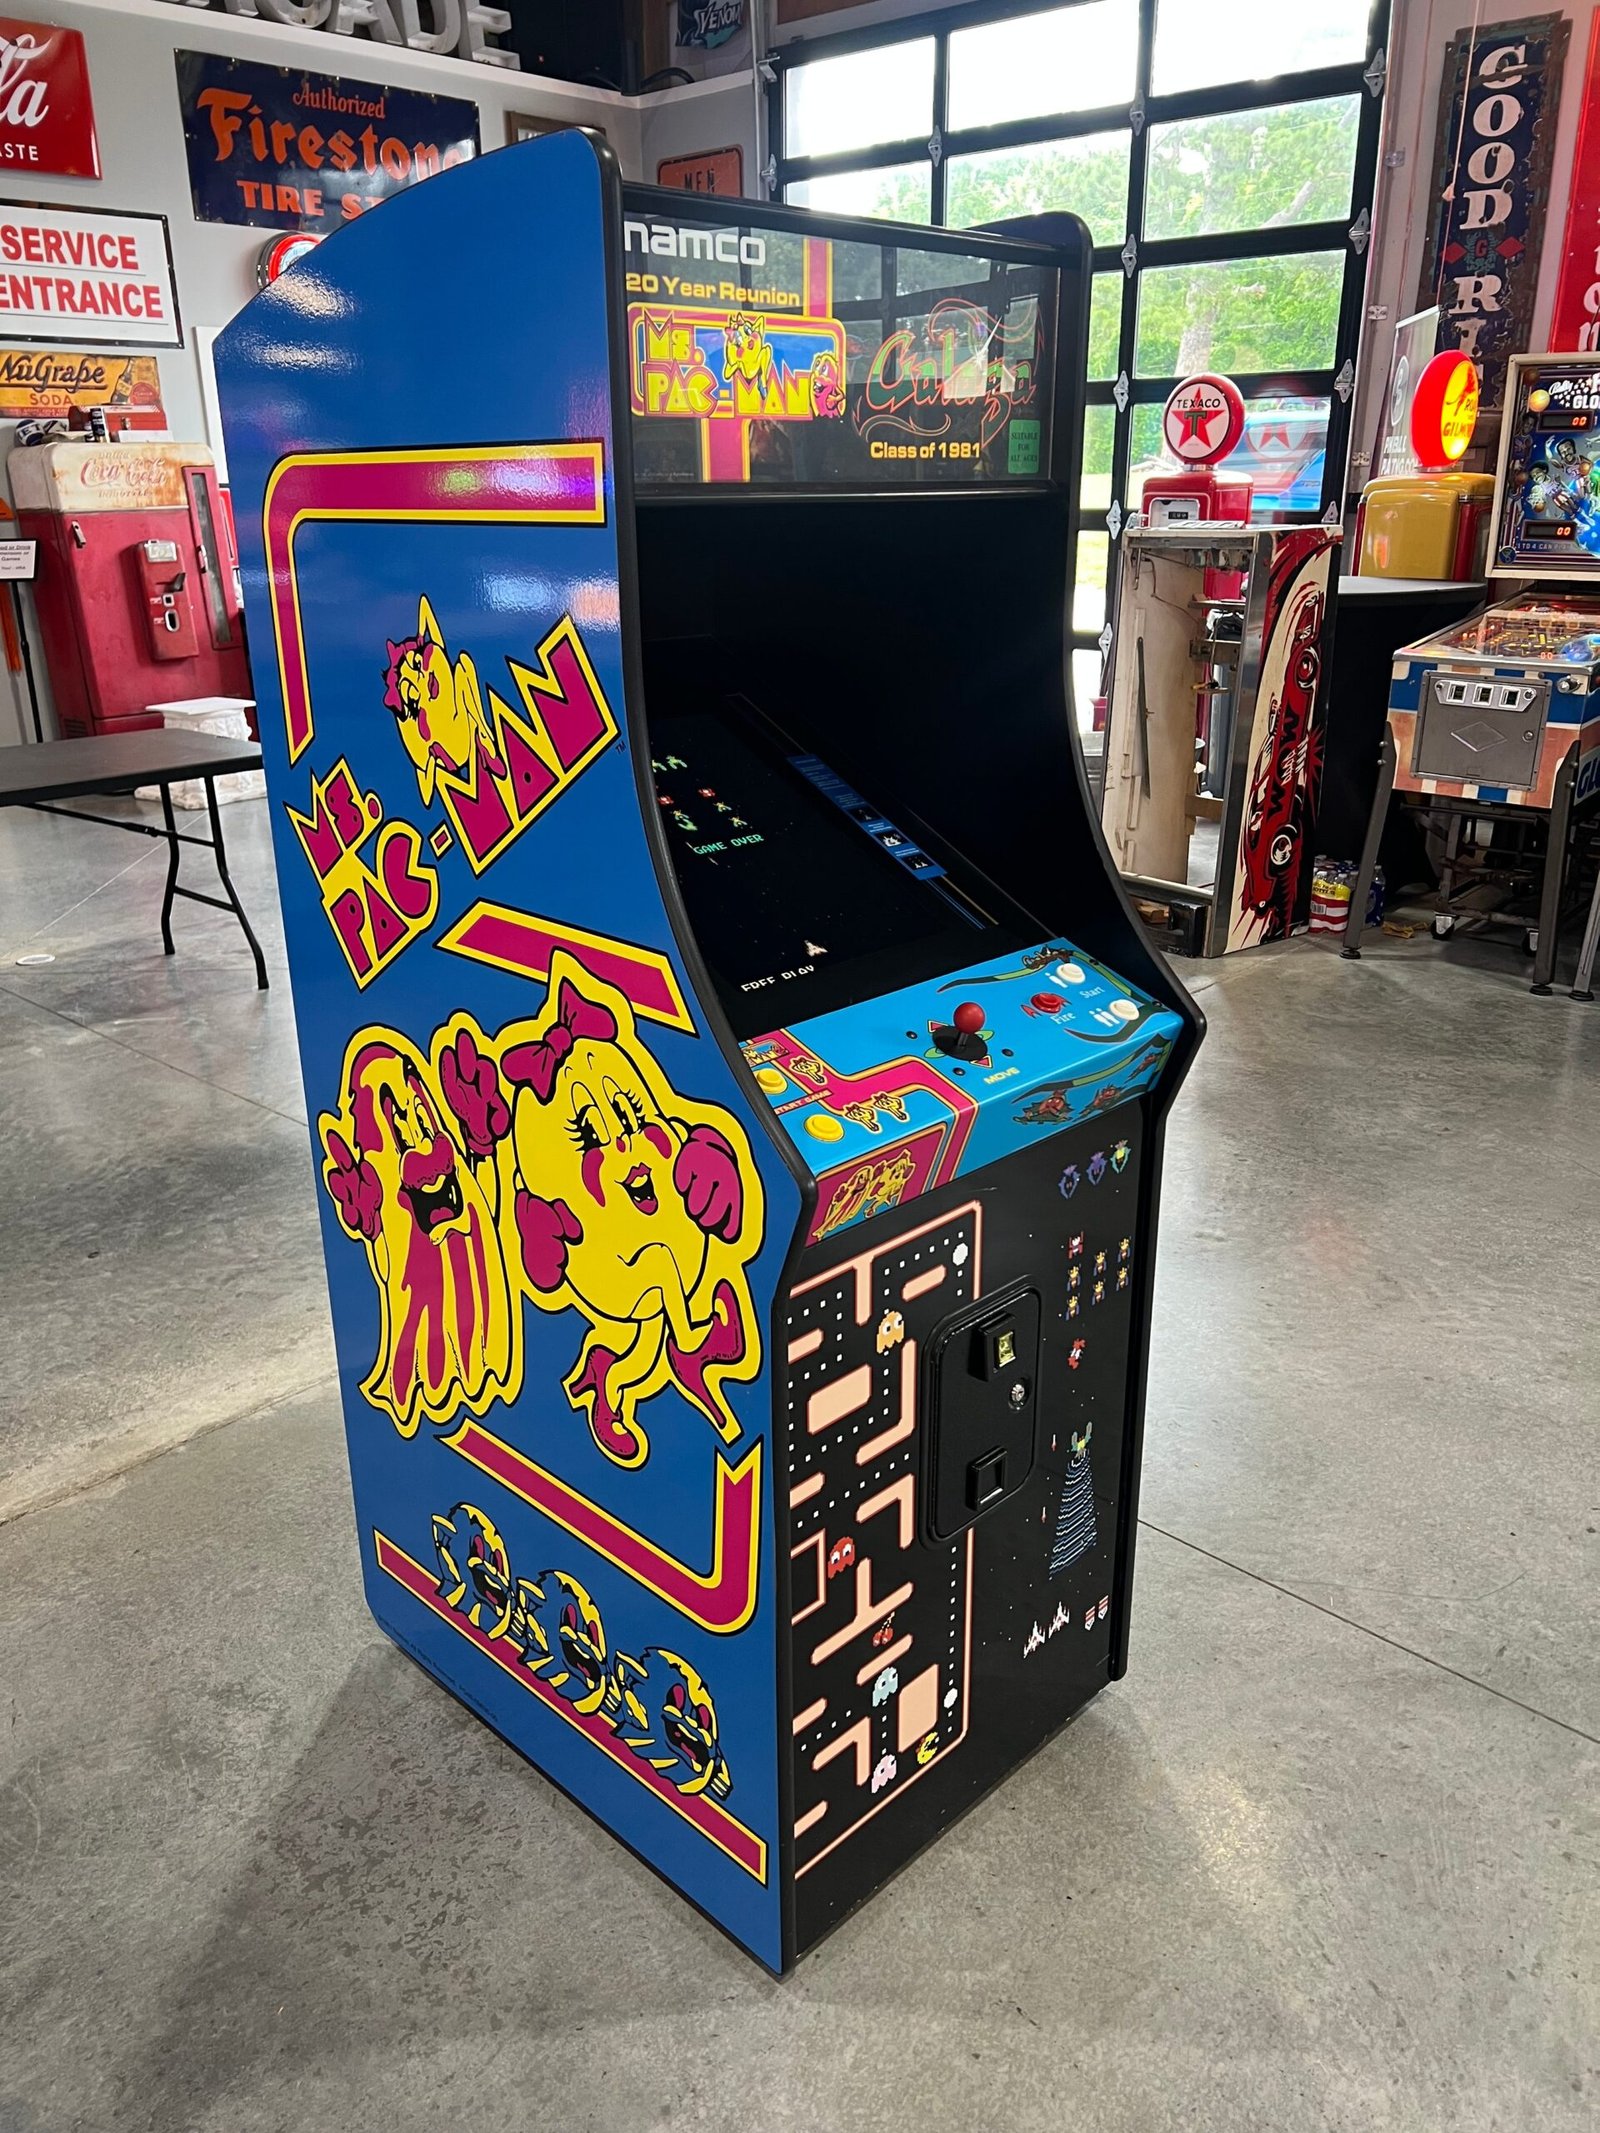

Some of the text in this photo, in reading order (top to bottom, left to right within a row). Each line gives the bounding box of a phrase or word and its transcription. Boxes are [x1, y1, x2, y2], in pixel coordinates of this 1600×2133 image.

[700, 3, 741, 34] VENOM
[292, 82, 387, 120] Authorized
[0, 142, 39, 161] STE
[684, 168, 716, 192] MEN
[236, 179, 325, 217] TIRE
[0, 224, 139, 270] SERVICE
[623, 220, 766, 267] namco
[625, 271, 800, 307] 20 Year Reunion
[0, 353, 106, 394] NuGrape
[29, 393, 74, 406] SODA
[1176, 397, 1221, 409] TEXACO
[1571, 416, 1588, 427] 00
[869, 441, 981, 459] Class of 1981
[1556, 526, 1572, 536] 00
[693, 833, 765, 855] GAME OVER
[1078, 986, 1106, 999] Start
[1050, 1011, 1076, 1026] Fire
[983, 1066, 1021, 1085] MOVE
